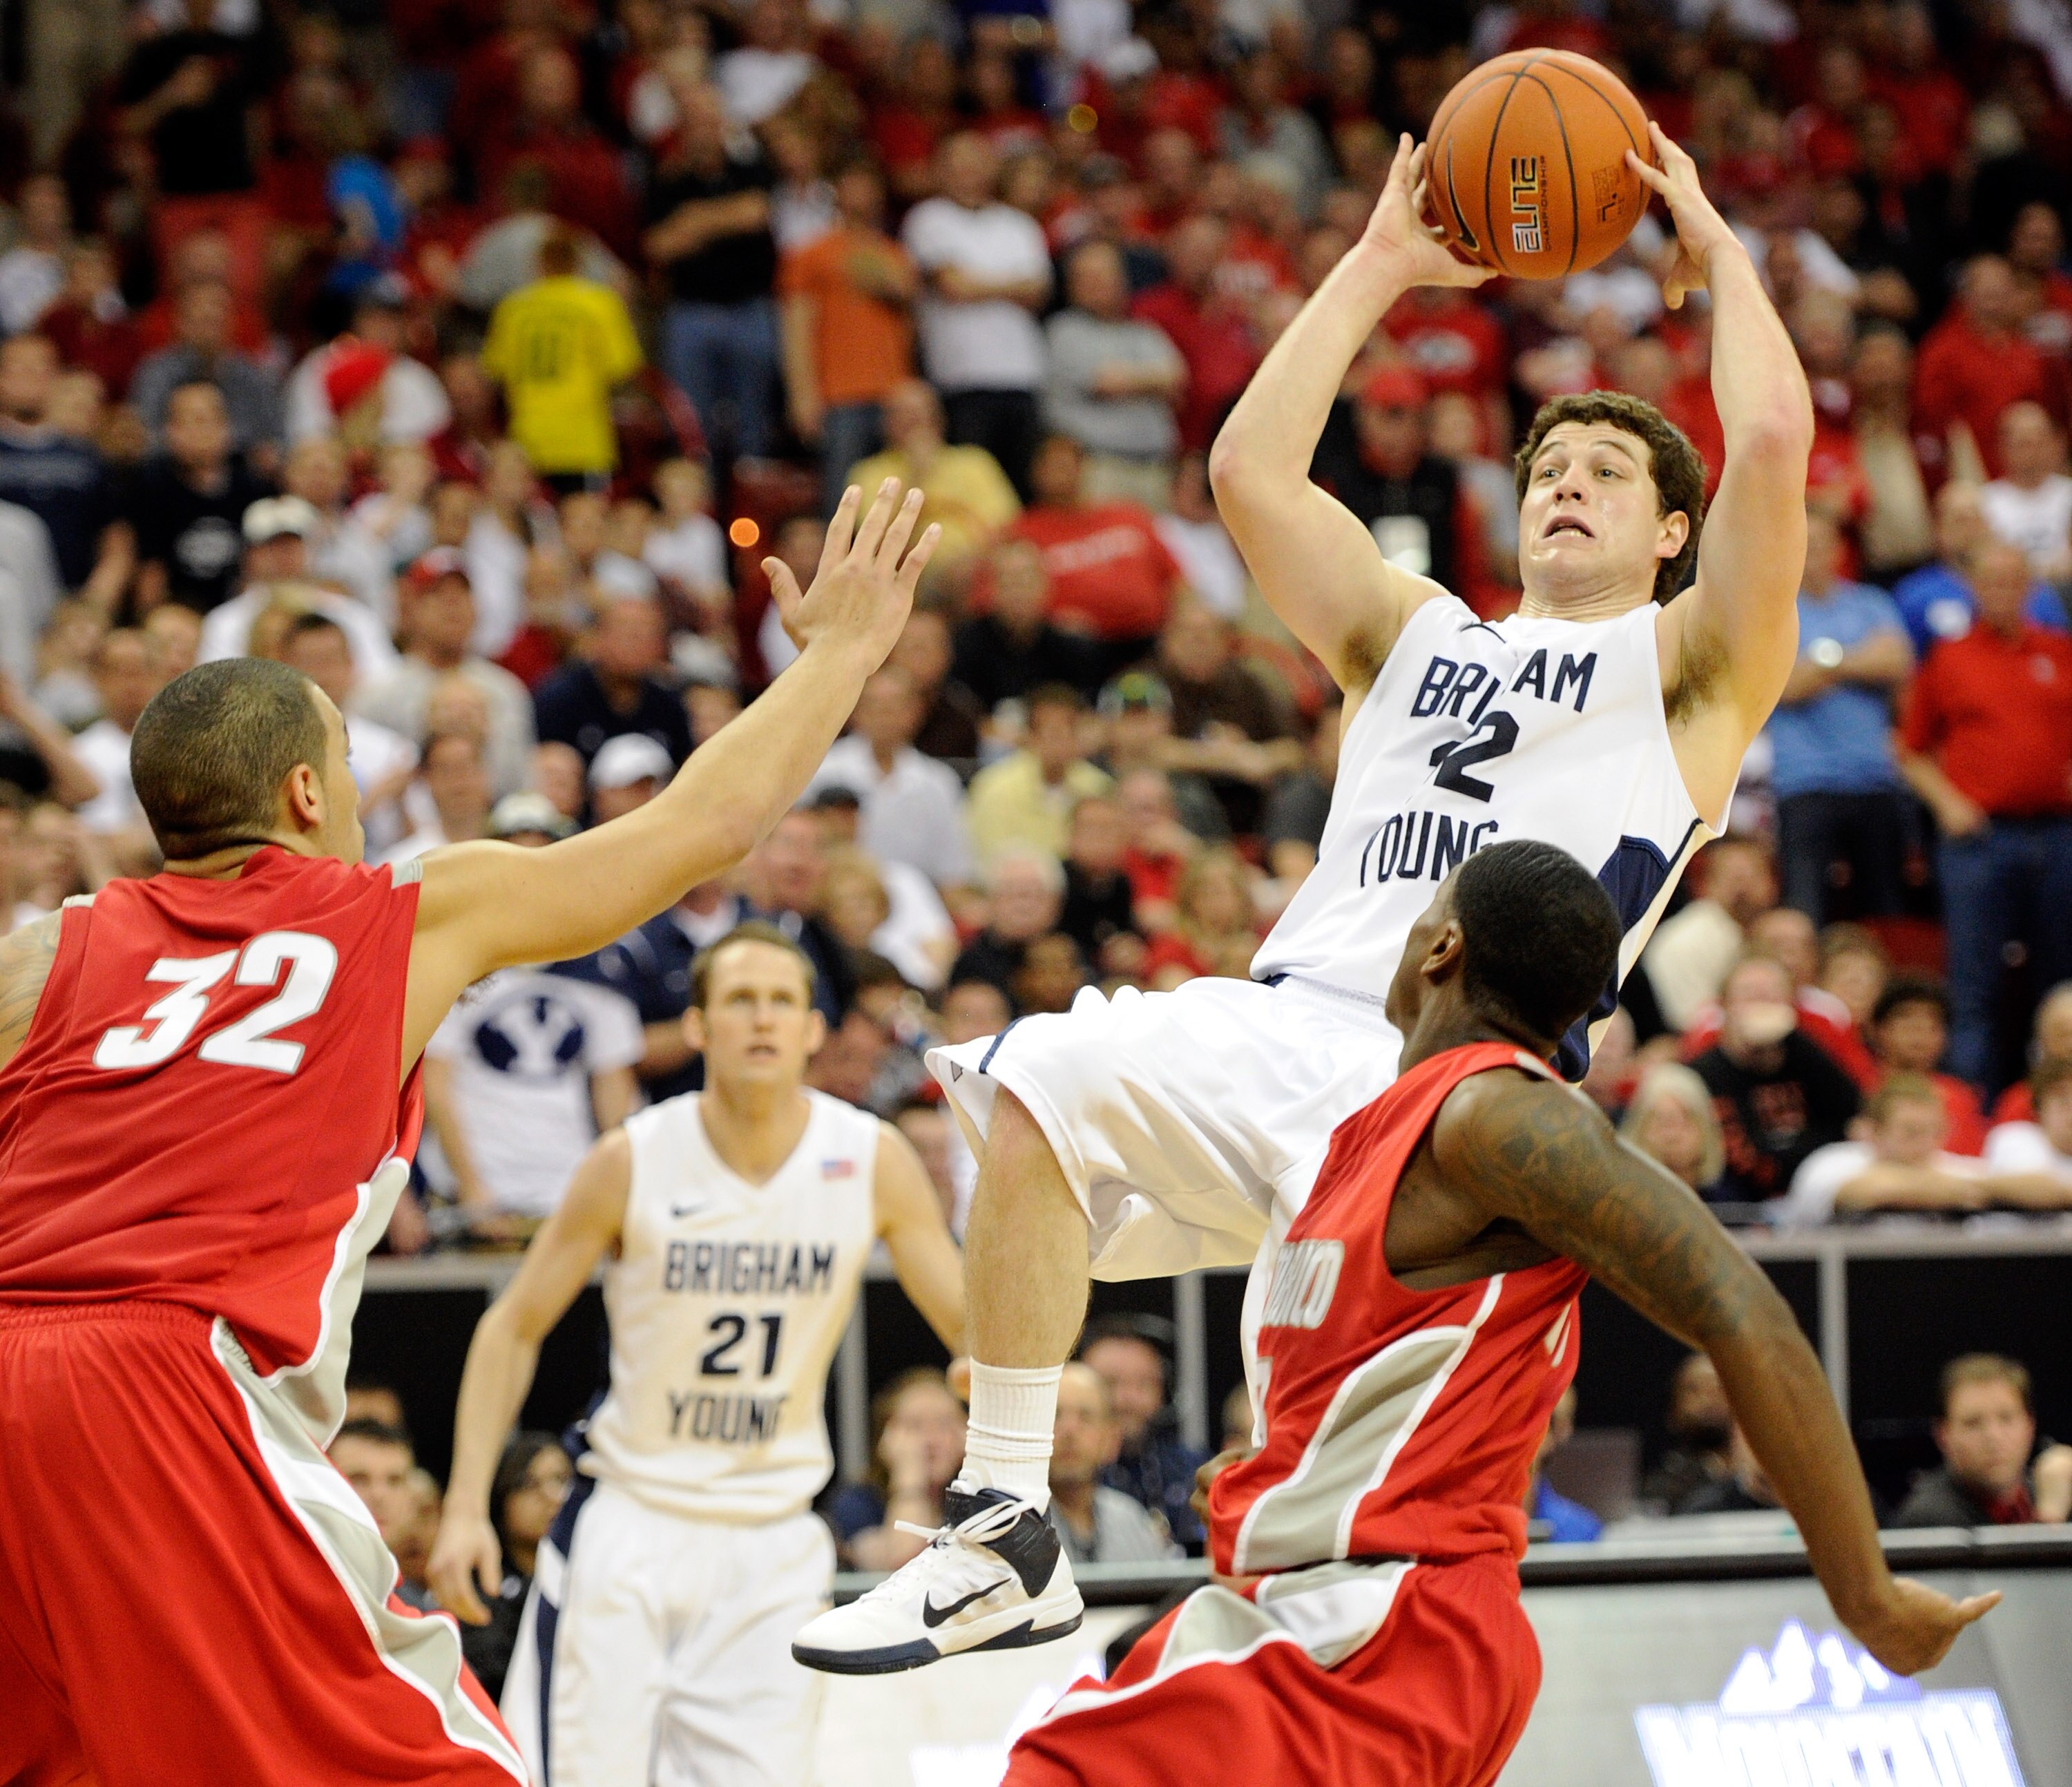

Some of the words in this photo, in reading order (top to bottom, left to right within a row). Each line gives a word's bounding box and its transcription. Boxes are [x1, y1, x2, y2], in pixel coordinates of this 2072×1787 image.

[1510, 155, 1543, 254] ELITE
[1410, 648, 1598, 725] BRIAM
[92, 930, 338, 1076] 32
[664, 1241, 837, 1296] BRIGHAM
[700, 1313, 783, 1377] 21
